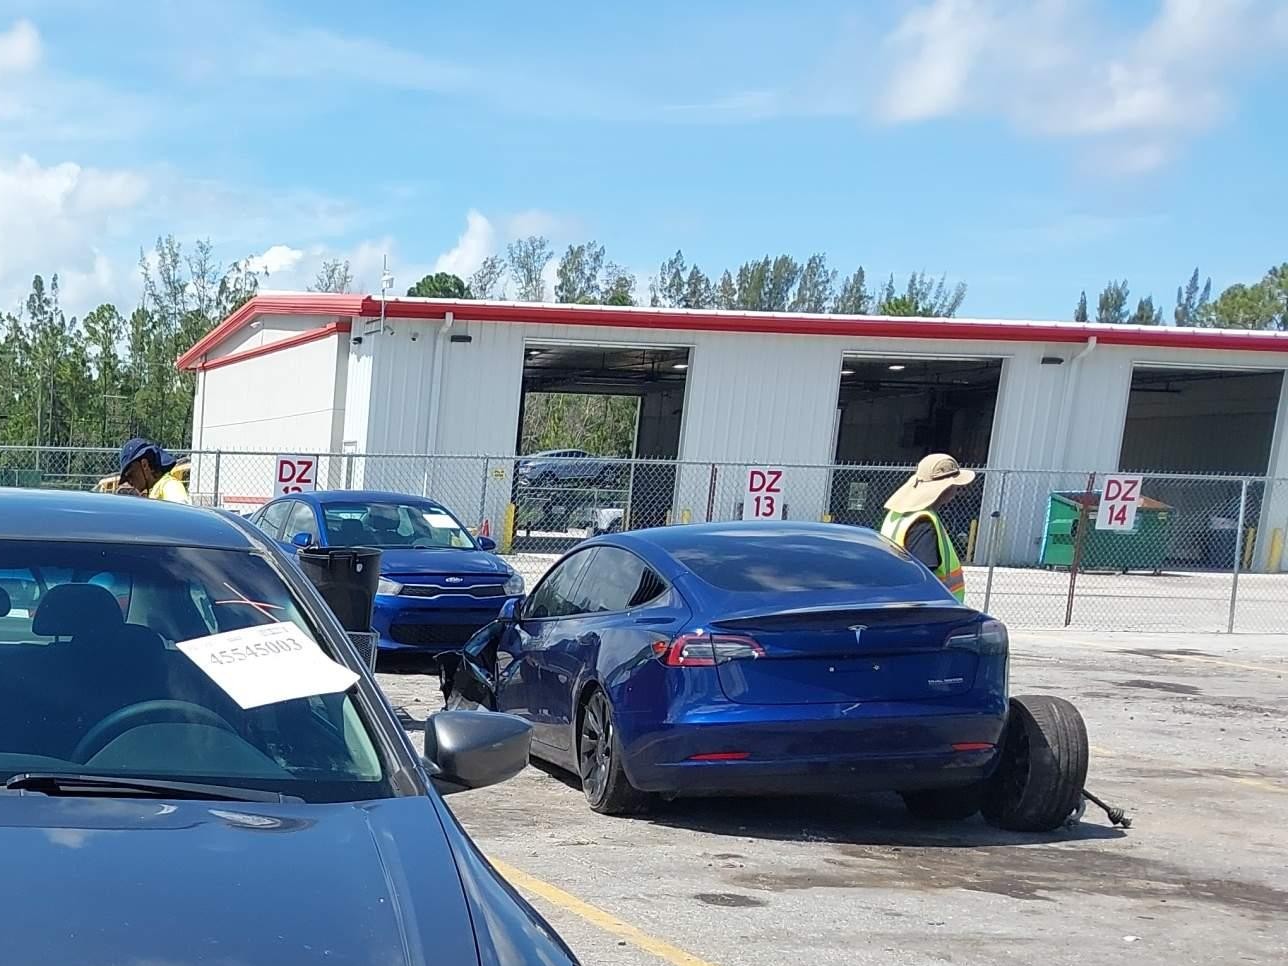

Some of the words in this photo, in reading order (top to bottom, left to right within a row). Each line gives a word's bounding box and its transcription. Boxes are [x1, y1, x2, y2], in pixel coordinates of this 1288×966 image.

[278, 460, 313, 483] DZ
[749, 471, 783, 493] DZ
[1104, 479, 1139, 502] DZ
[754, 496, 775, 517] 13
[1108, 504, 1128, 525] 14
[210, 638, 303, 663] 45545003
